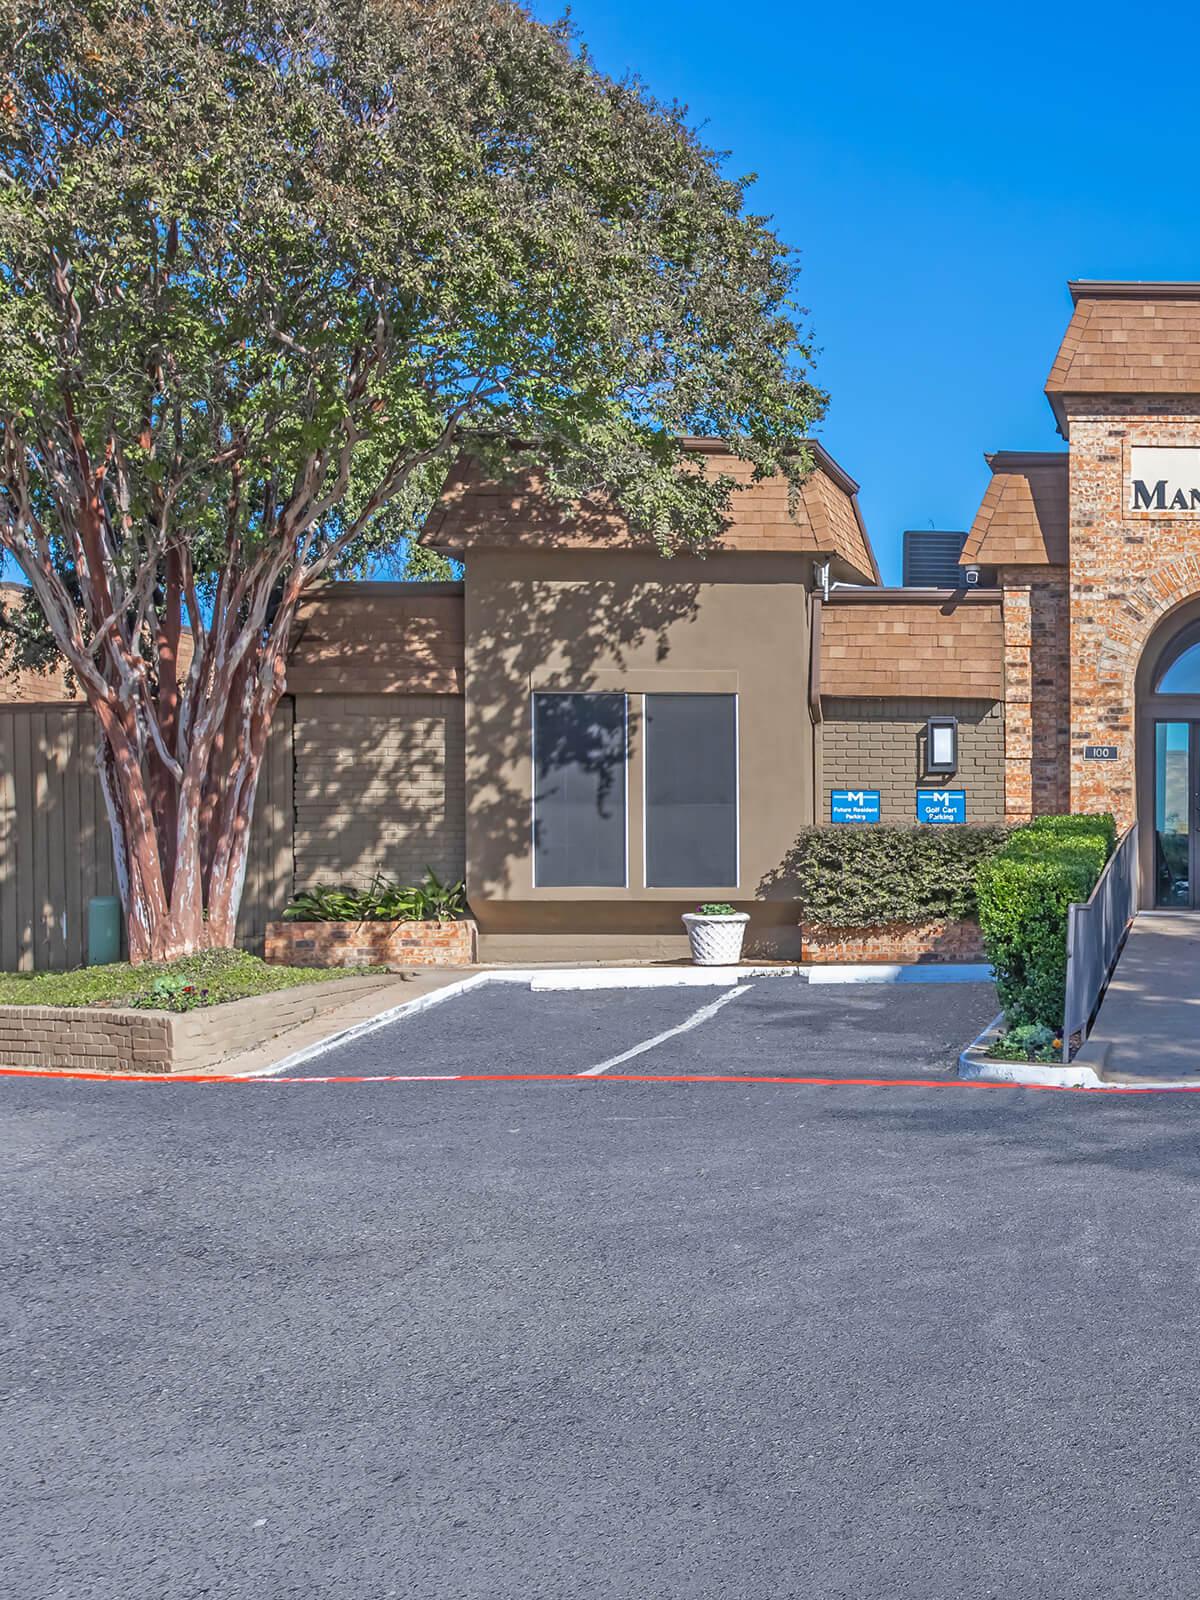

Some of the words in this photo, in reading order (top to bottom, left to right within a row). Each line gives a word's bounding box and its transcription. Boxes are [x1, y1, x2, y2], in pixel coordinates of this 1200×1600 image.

[1093, 747, 1109, 758] 100
[925, 806, 940, 814] Golf
[942, 806, 957, 814] Cart
[928, 814, 954, 822] Parking
